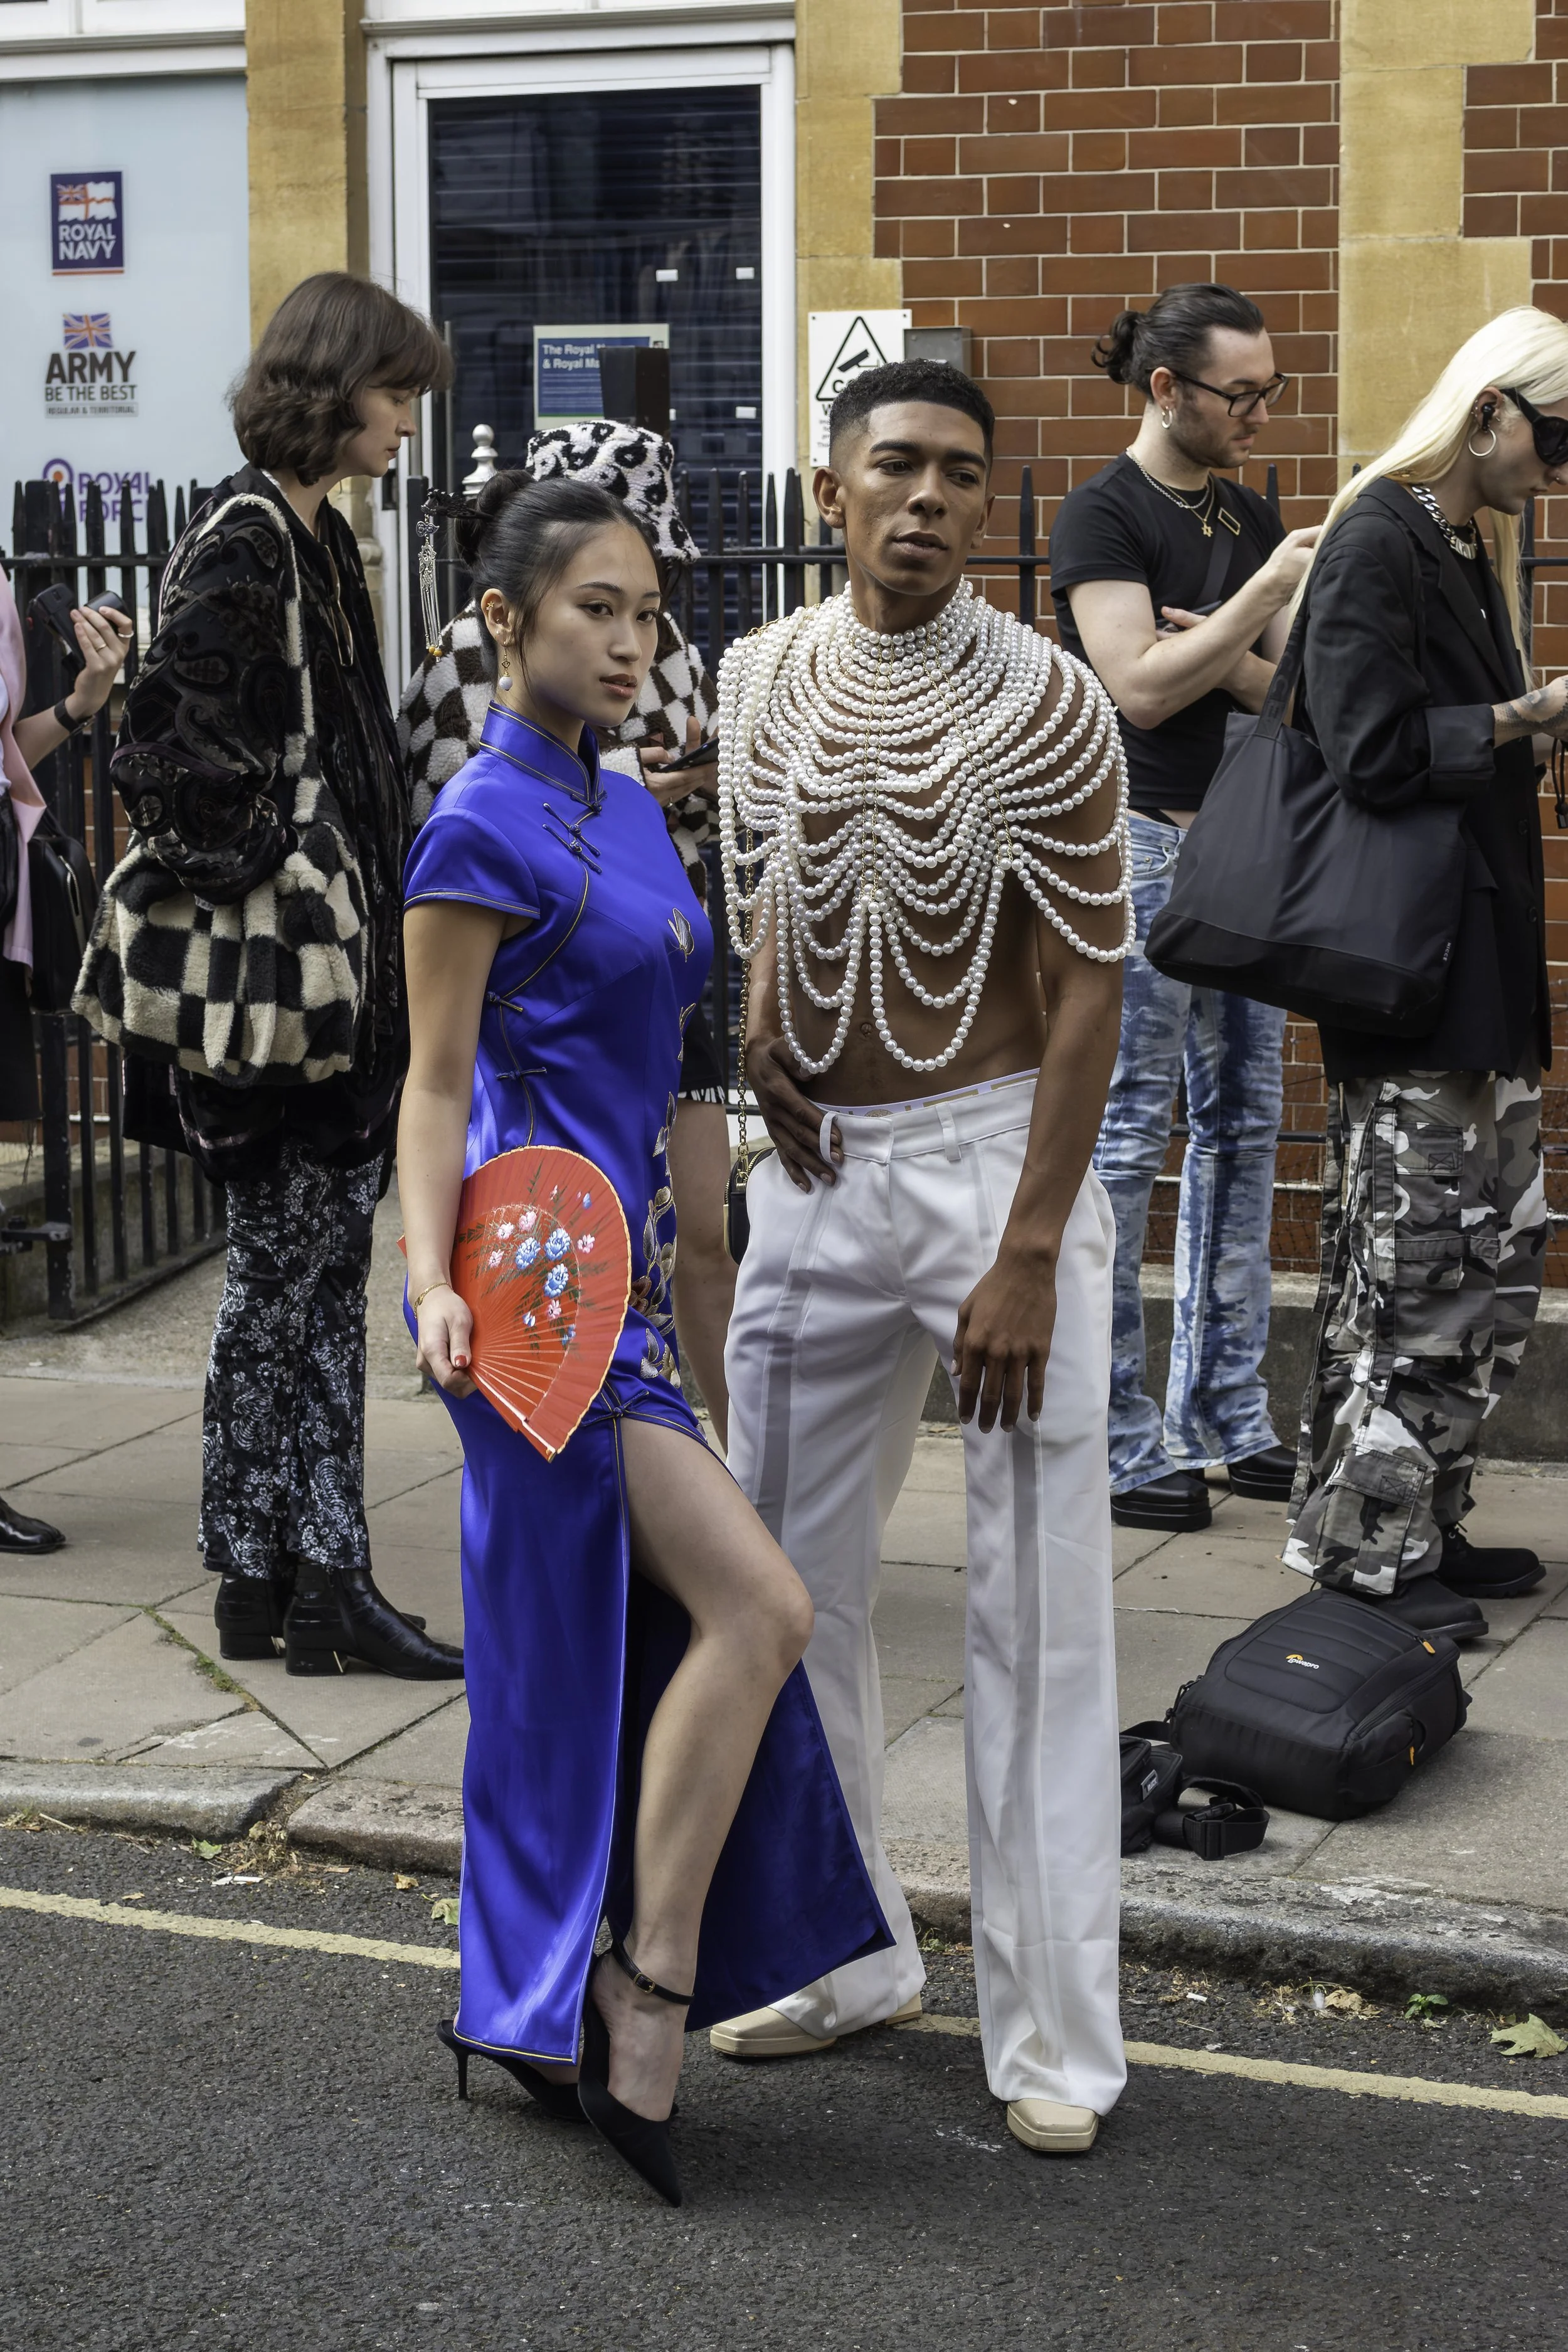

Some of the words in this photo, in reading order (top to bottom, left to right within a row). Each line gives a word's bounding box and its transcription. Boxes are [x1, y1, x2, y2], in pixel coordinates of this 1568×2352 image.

[58, 223, 117, 241] ROYAL
[58, 240, 116, 260] NAVY
[542, 344, 563, 355] The
[564, 344, 595, 357] Royal
[45, 351, 136, 384] ARMY
[542, 358, 551, 369] &
[553, 358, 584, 371] Royal
[45, 386, 63, 401] BE
[66, 385, 96, 401] THE
[100, 384, 137, 400] BEST
